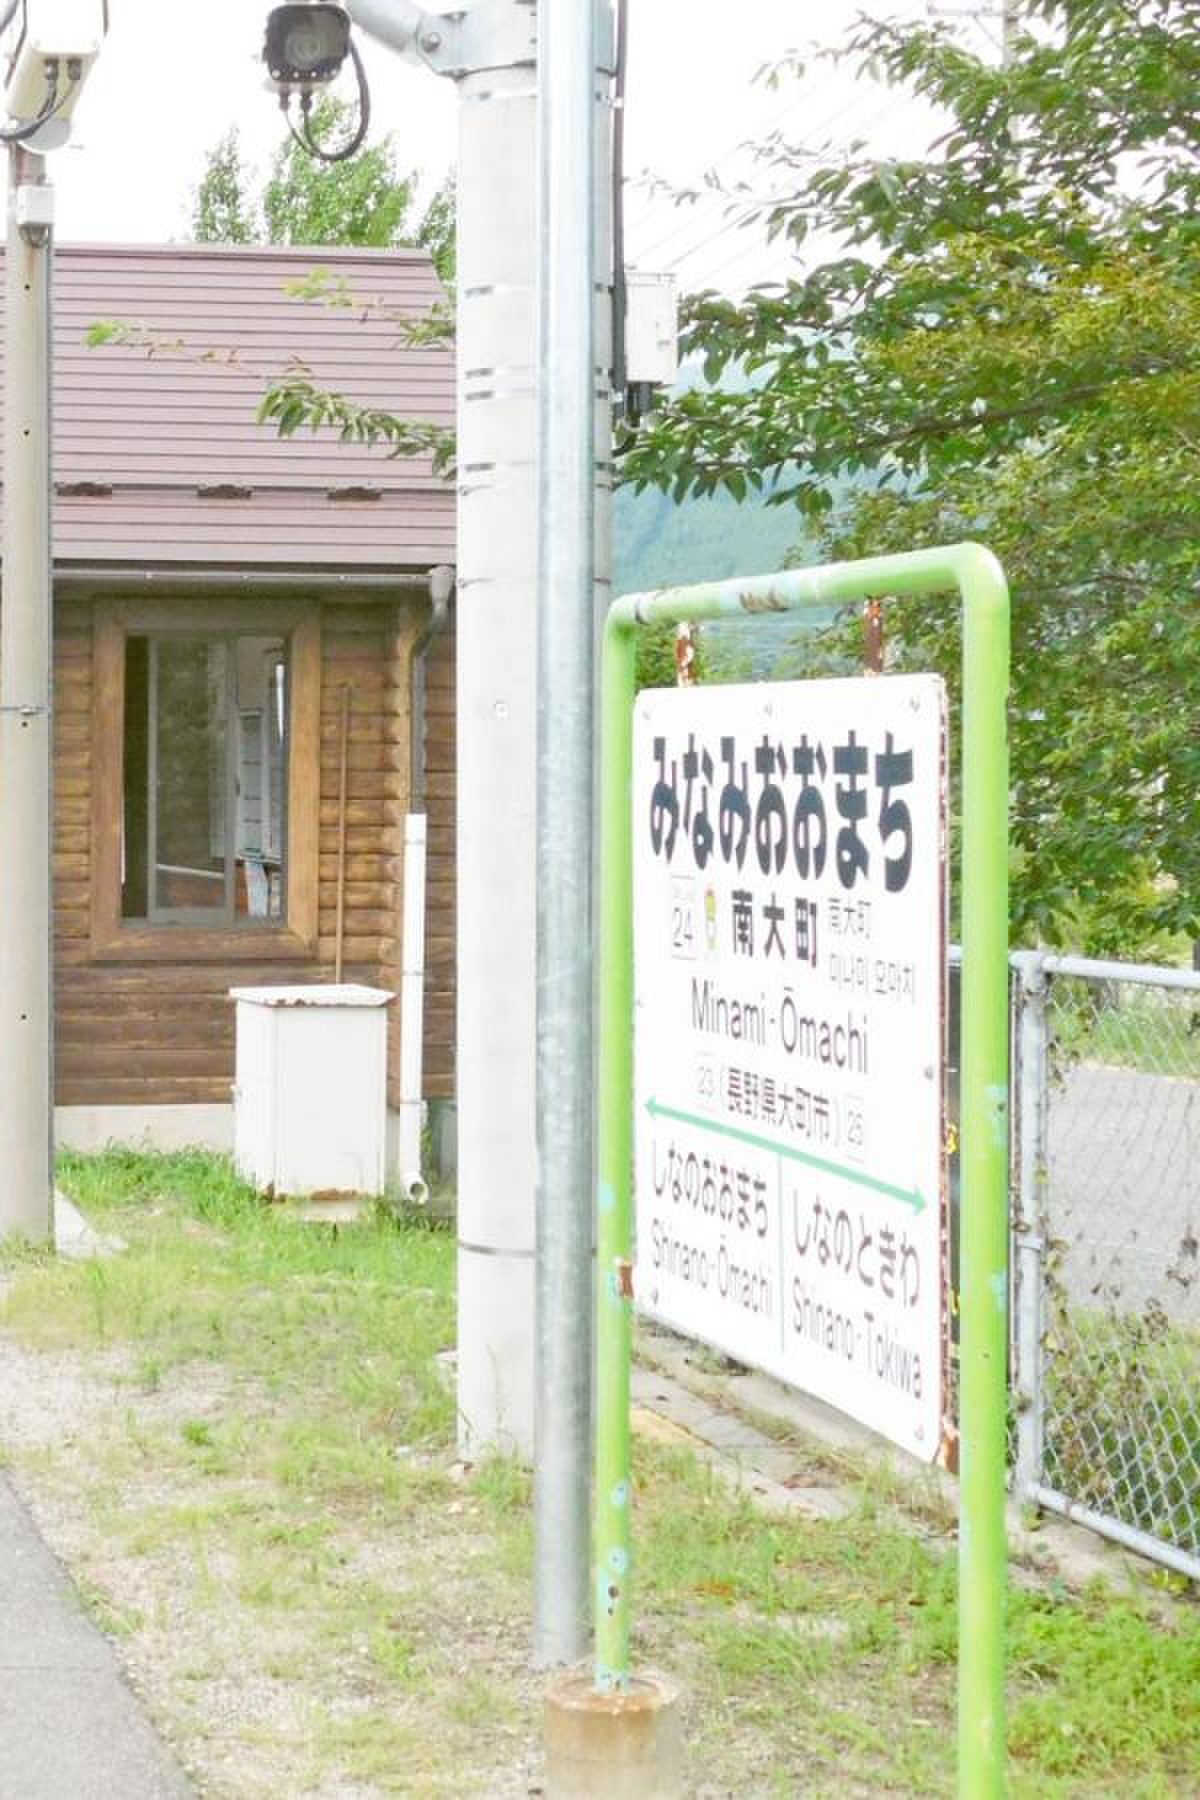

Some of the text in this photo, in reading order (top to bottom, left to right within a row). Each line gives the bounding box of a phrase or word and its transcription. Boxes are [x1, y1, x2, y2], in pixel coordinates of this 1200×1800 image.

[650, 729, 914, 893] みなみおおまち
[731, 889, 817, 968] 南大町
[652, 1140, 769, 1238] しなのおおまち
[793, 1189, 920, 1308] しなのときわ
